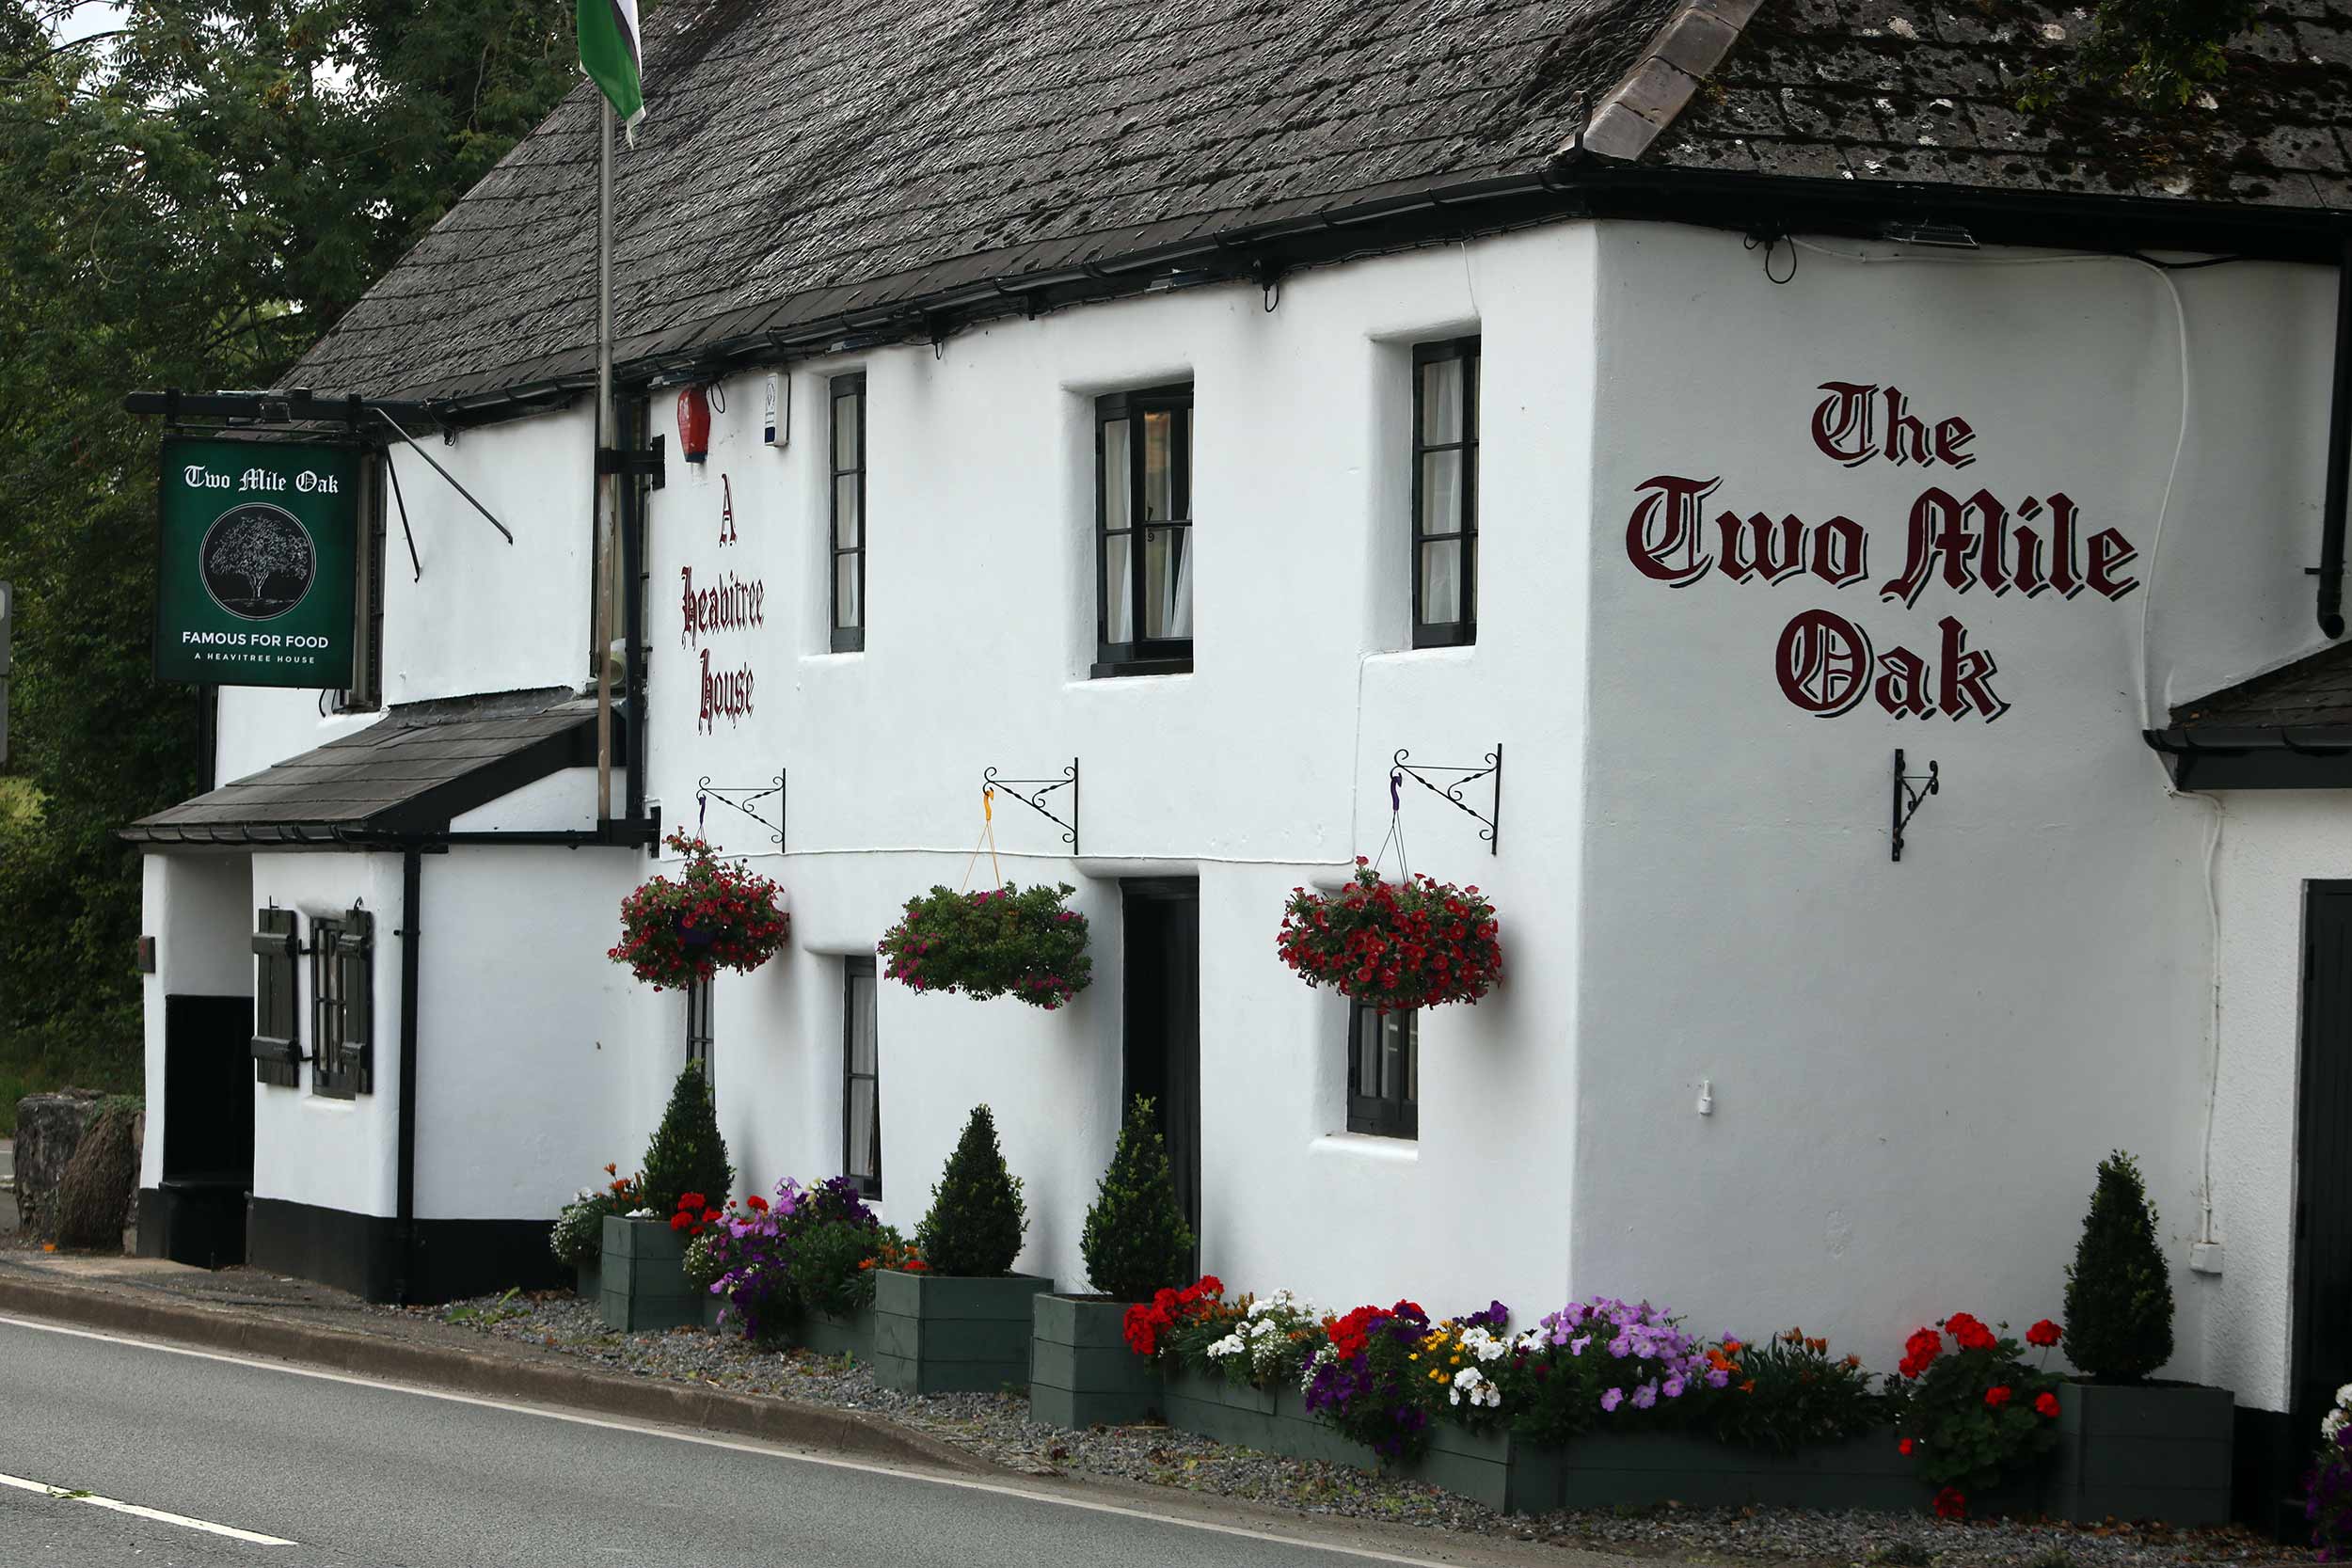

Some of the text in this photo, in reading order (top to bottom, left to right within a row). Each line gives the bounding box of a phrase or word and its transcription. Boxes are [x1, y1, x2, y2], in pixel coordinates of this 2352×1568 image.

[1811, 381, 1976, 469] The
[183, 465, 339, 494] Two Mile Oak
[718, 473, 738, 548] A
[1626, 475, 2139, 610] Two Mile
[182, 631, 328, 649] FAMOUS FOR FOOD
[207, 653, 271, 663] HEAVITREE
[277, 656, 315, 664] HOUSE
[1775, 609, 2011, 724] Oak
